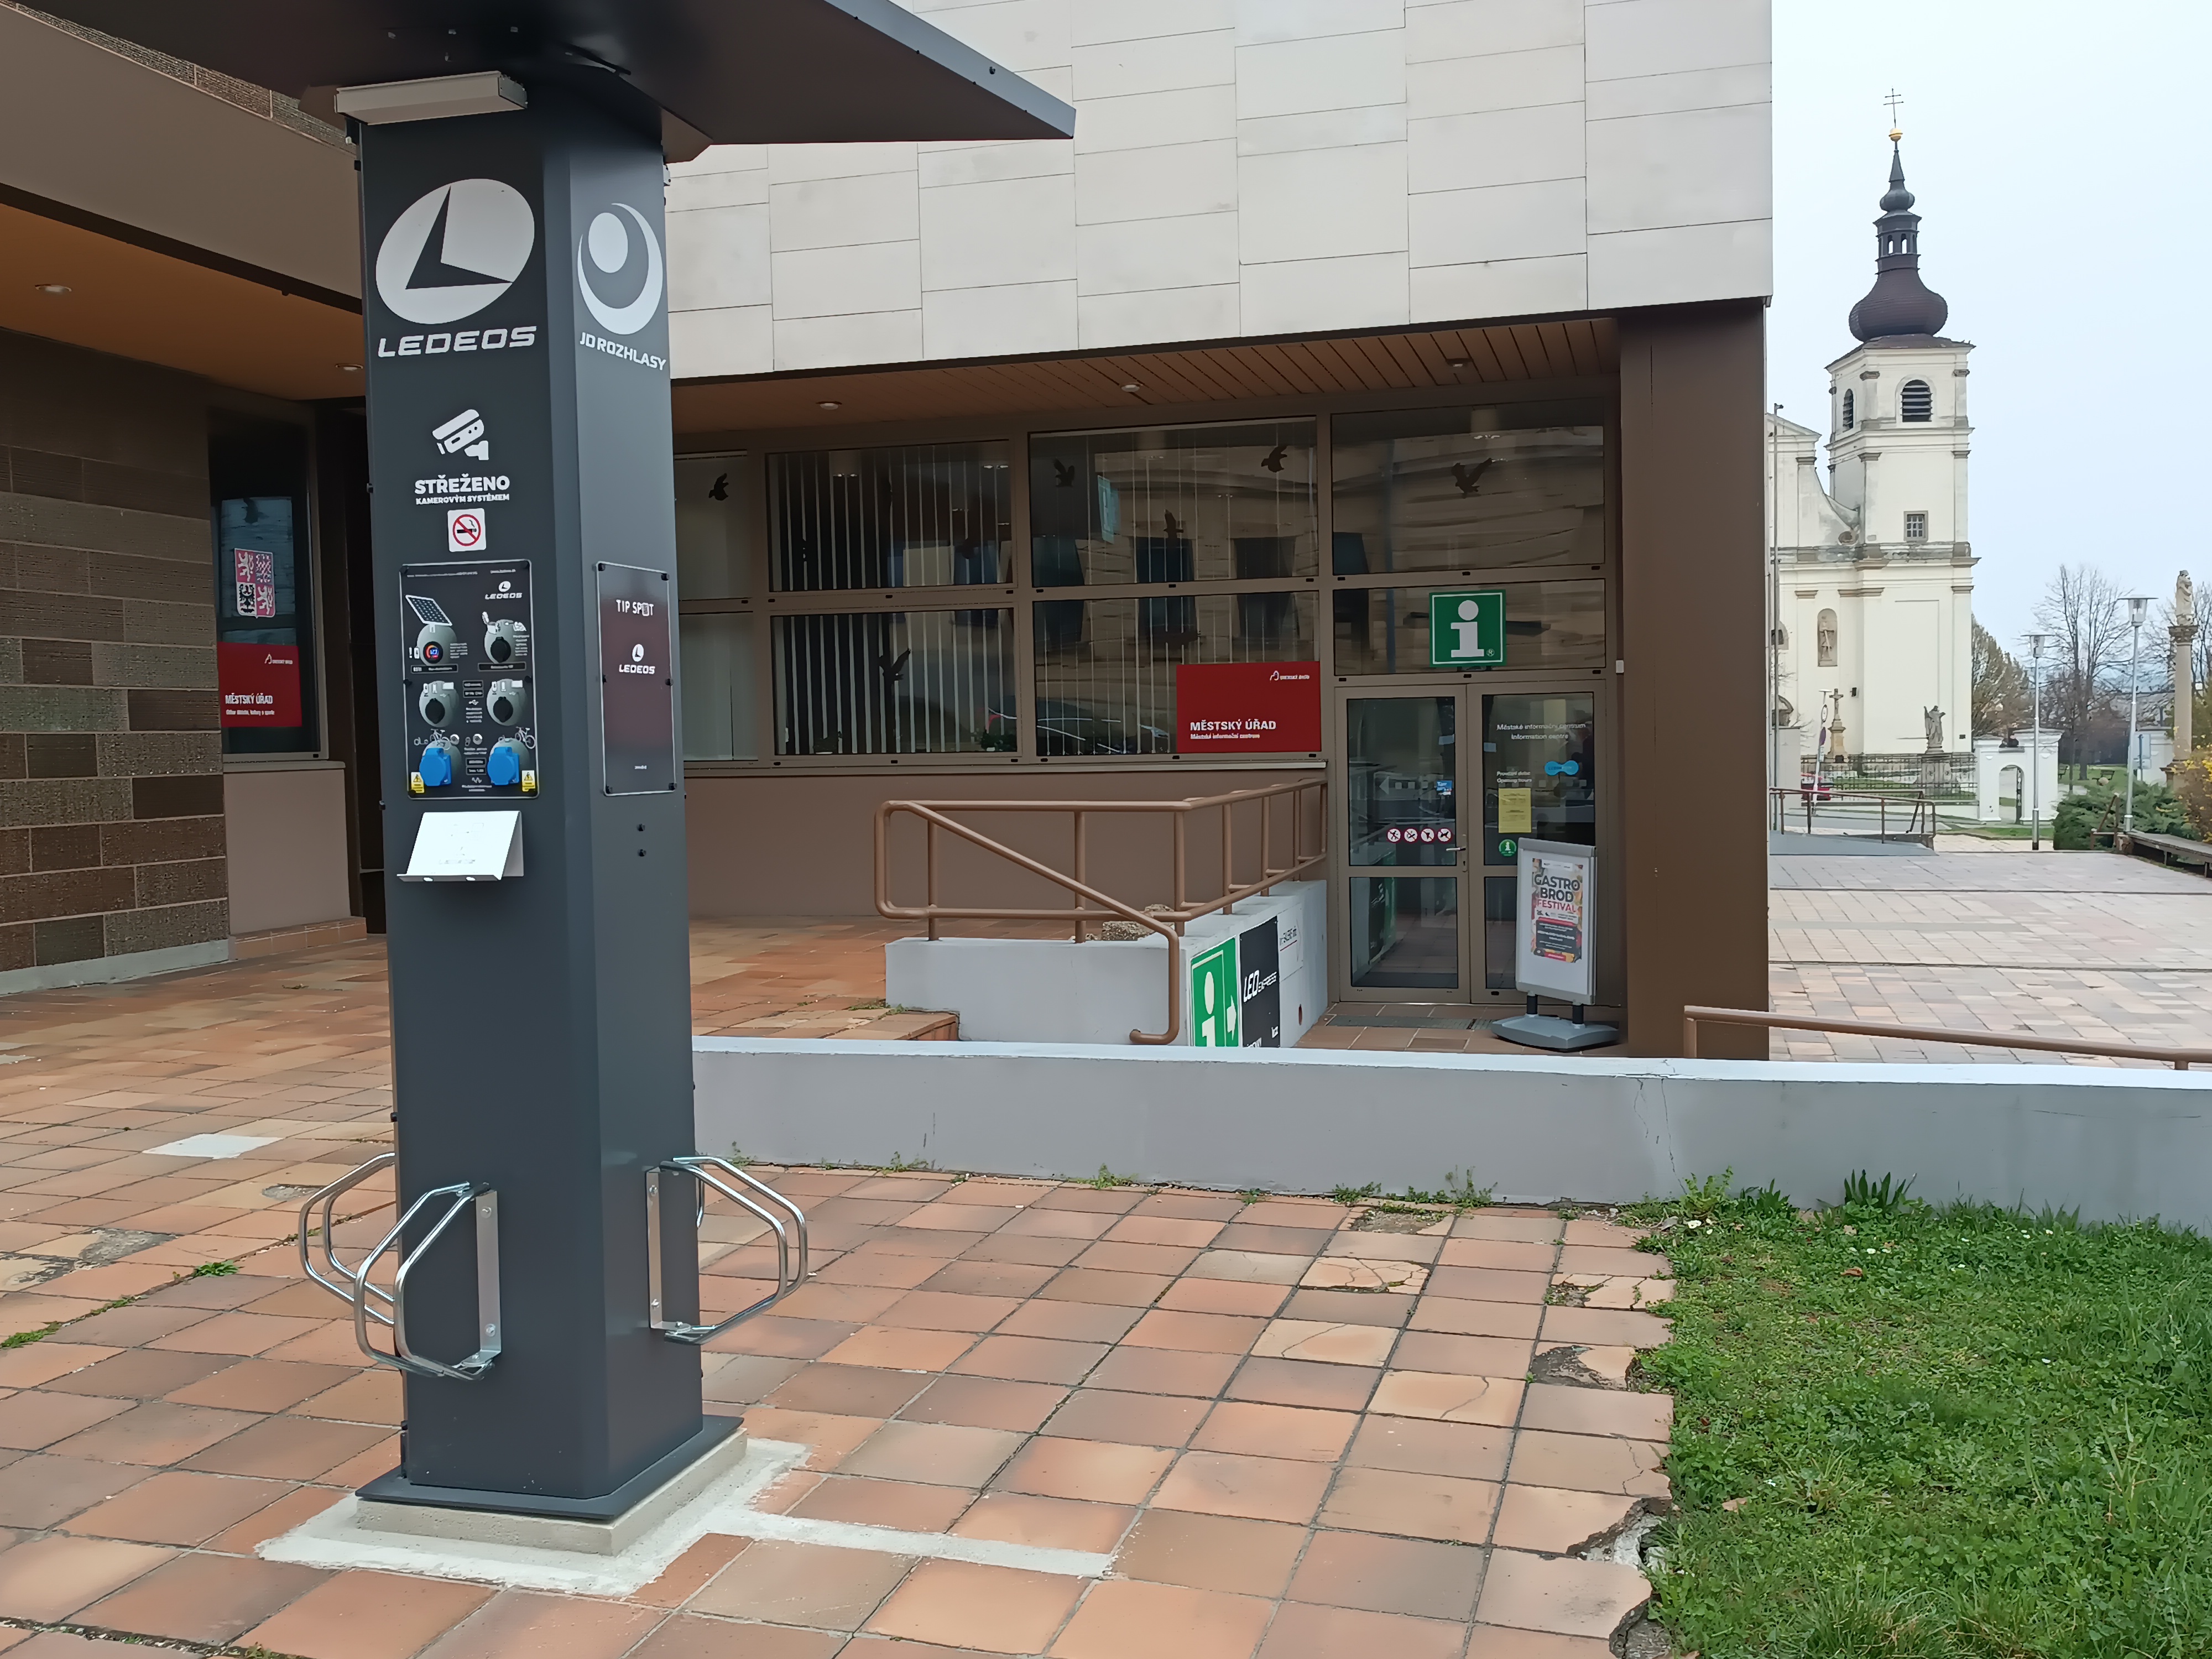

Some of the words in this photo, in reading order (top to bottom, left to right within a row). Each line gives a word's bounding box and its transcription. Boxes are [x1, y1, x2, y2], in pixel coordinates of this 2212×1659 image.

[378, 326, 536, 357] LEDEOS
[580, 332, 596, 348] JD
[597, 338, 666, 371] ROZHLASY
[415, 473, 510, 494] STŘEŽENO
[616, 599, 630, 613] TIP
[632, 602, 654, 616] SPOT
[619, 664, 655, 674] LEDEOS
[225, 692, 254, 704] MĚSTSKÝ
[256, 692, 273, 704] ÚŘAD
[1190, 719, 1242, 731] MĚSTSKÝ
[1245, 719, 1276, 730] ÚŘAD
[1534, 874, 1580, 891] GASTRO
[1540, 887, 1574, 902] BROD
[1537, 899, 1577, 912] FESTIVAL
[1244, 969, 1259, 1003] LEO
